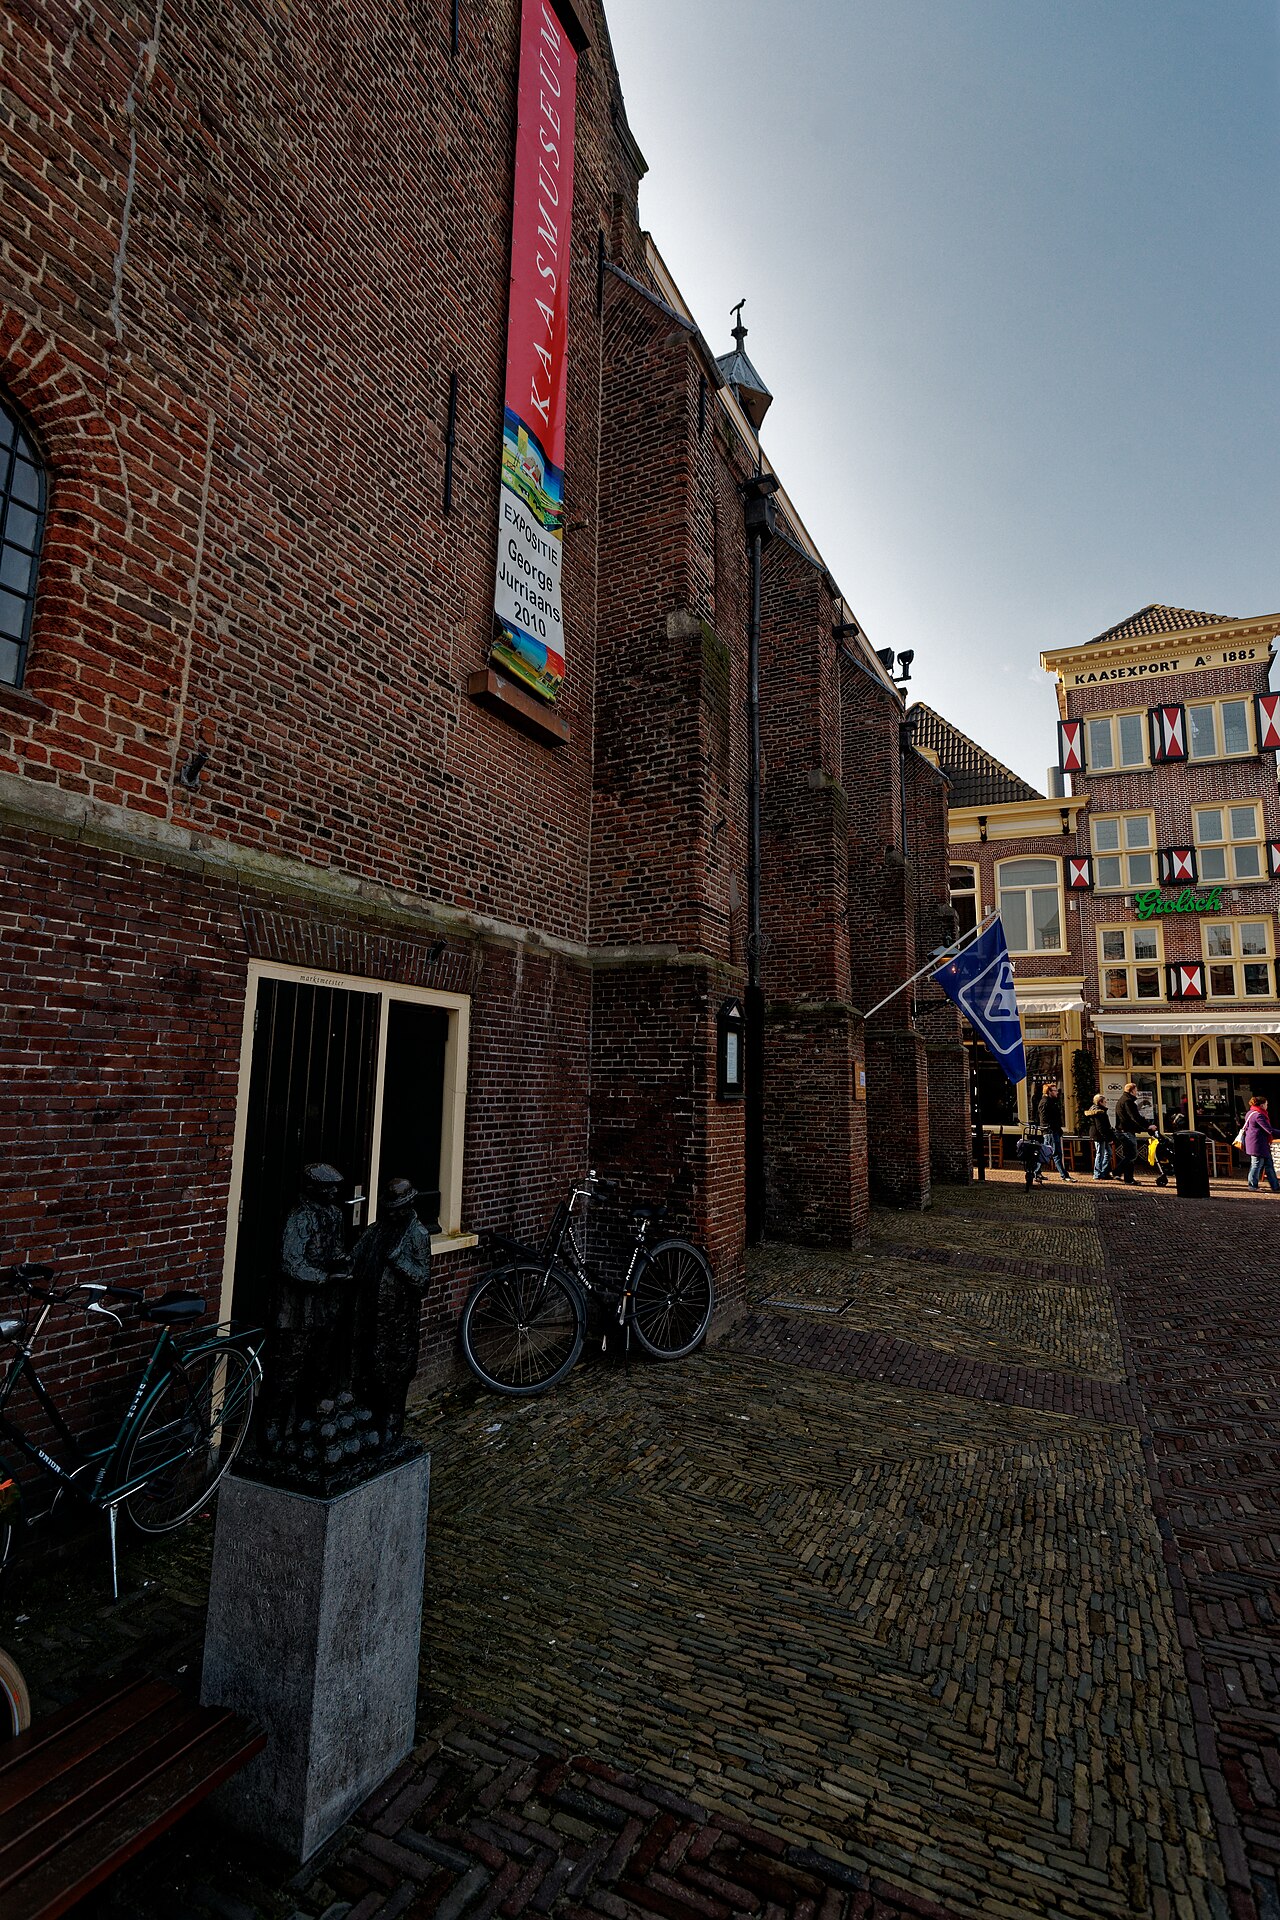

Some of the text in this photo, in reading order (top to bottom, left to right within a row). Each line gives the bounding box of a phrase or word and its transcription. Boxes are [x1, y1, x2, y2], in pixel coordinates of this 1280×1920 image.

[529, 3, 562, 428] KAASMUSEUM
[504, 503, 558, 567] EXPOSITIE
[508, 539, 553, 593] George
[514, 601, 547, 638] 2010
[1075, 660, 1180, 685] KAASEXPORT
[1223, 649, 1256, 663] 1885
[1135, 886, 1223, 920] Grolsch
[127, 1383, 146, 1418] UNION
[38, 1449, 62, 1474] UNION
